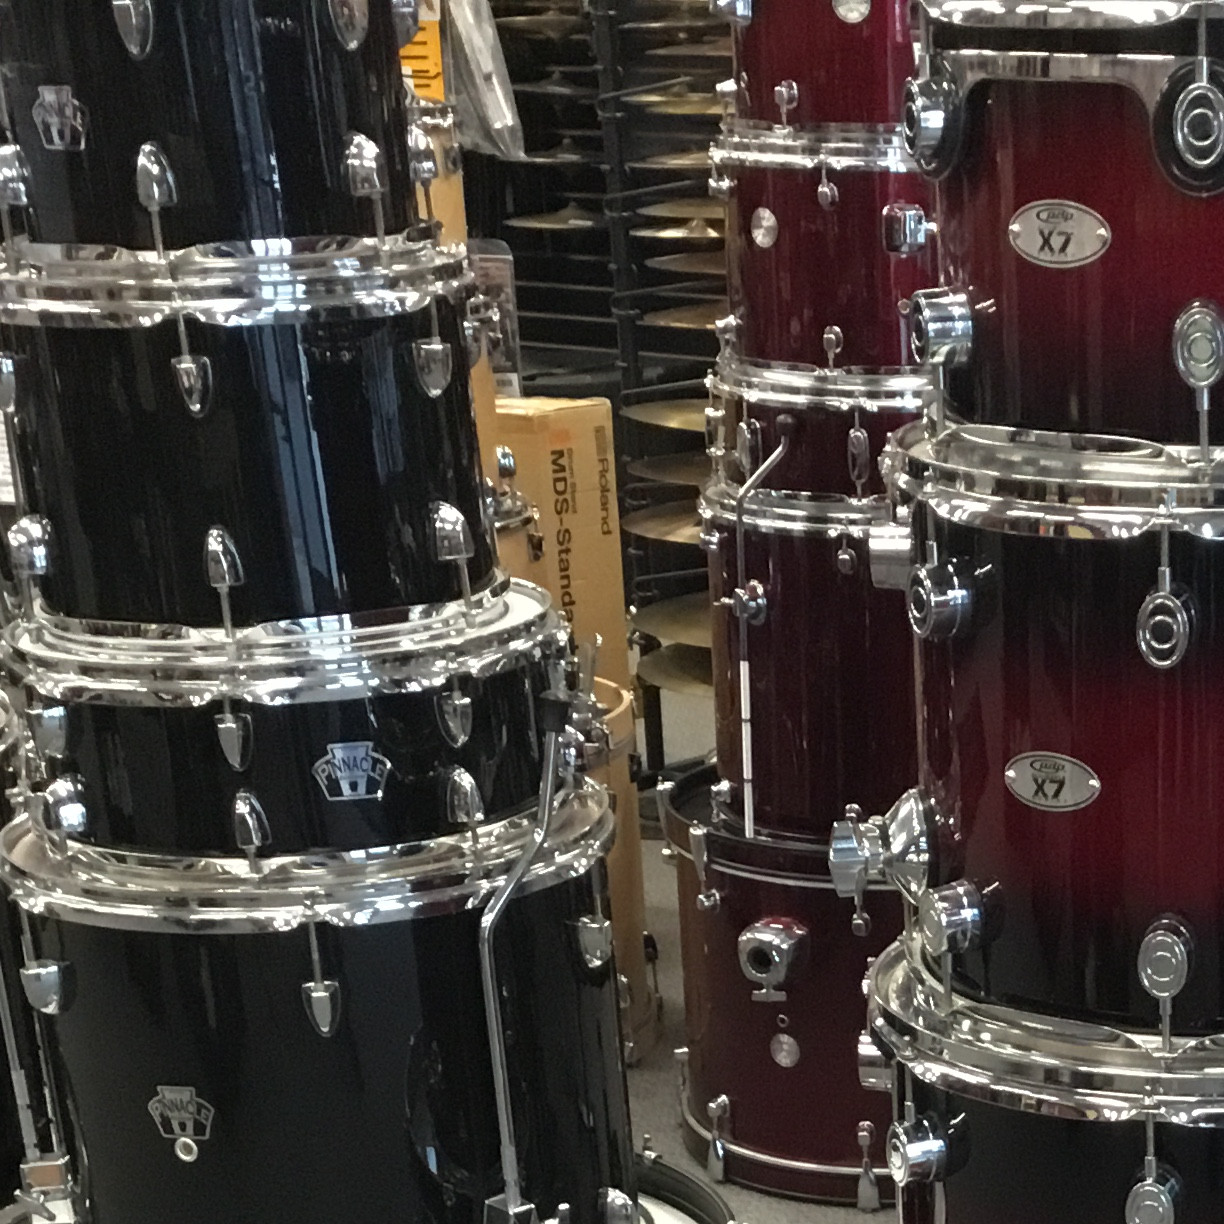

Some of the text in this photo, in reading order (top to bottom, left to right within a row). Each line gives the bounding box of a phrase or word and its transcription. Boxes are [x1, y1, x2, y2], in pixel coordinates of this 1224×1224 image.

[1038, 227, 1075, 256] X7
[598, 457, 613, 535] Roland
[550, 449, 579, 654] MDS-Standa
[317, 754, 387, 786] PINNACLE
[1031, 774, 1066, 801] X7
